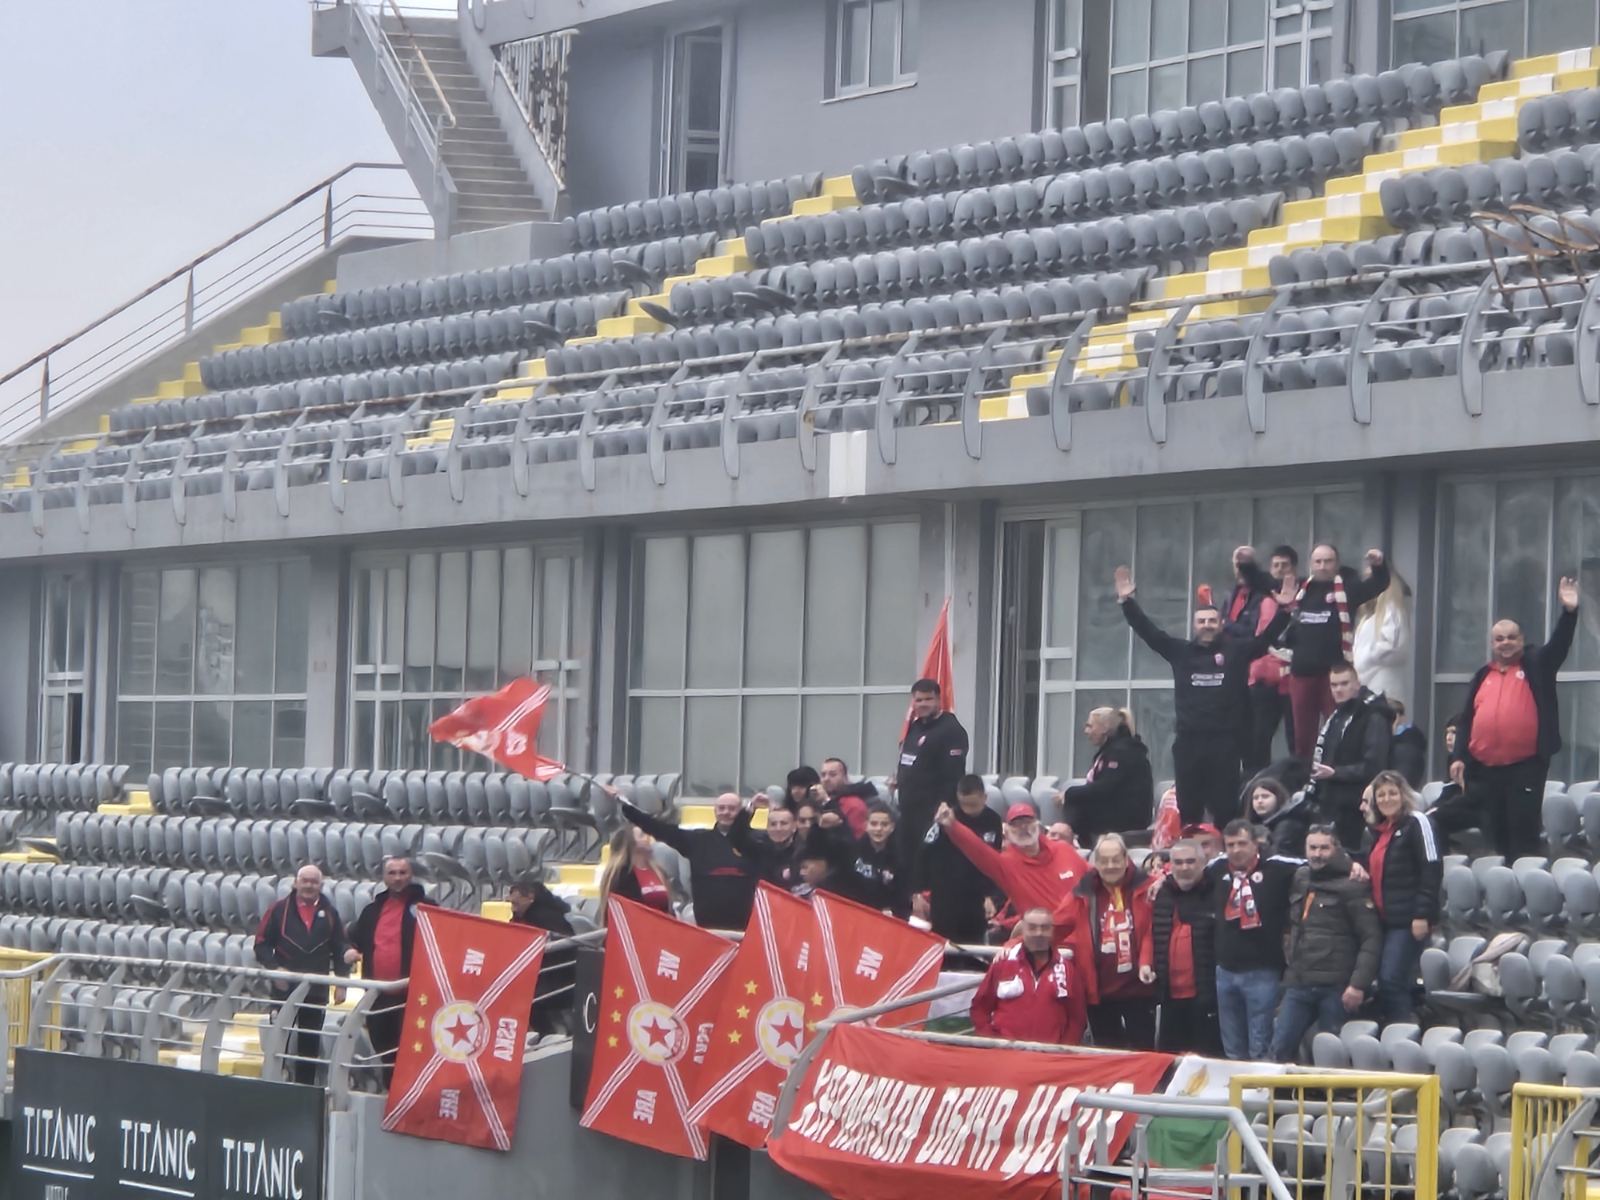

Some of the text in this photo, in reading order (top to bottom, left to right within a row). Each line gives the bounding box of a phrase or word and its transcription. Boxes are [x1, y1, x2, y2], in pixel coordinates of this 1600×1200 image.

[23, 1106, 96, 1163] TITANIC
[120, 1120, 197, 1181] TITANIC
[222, 1138, 304, 1200] TITANIC
